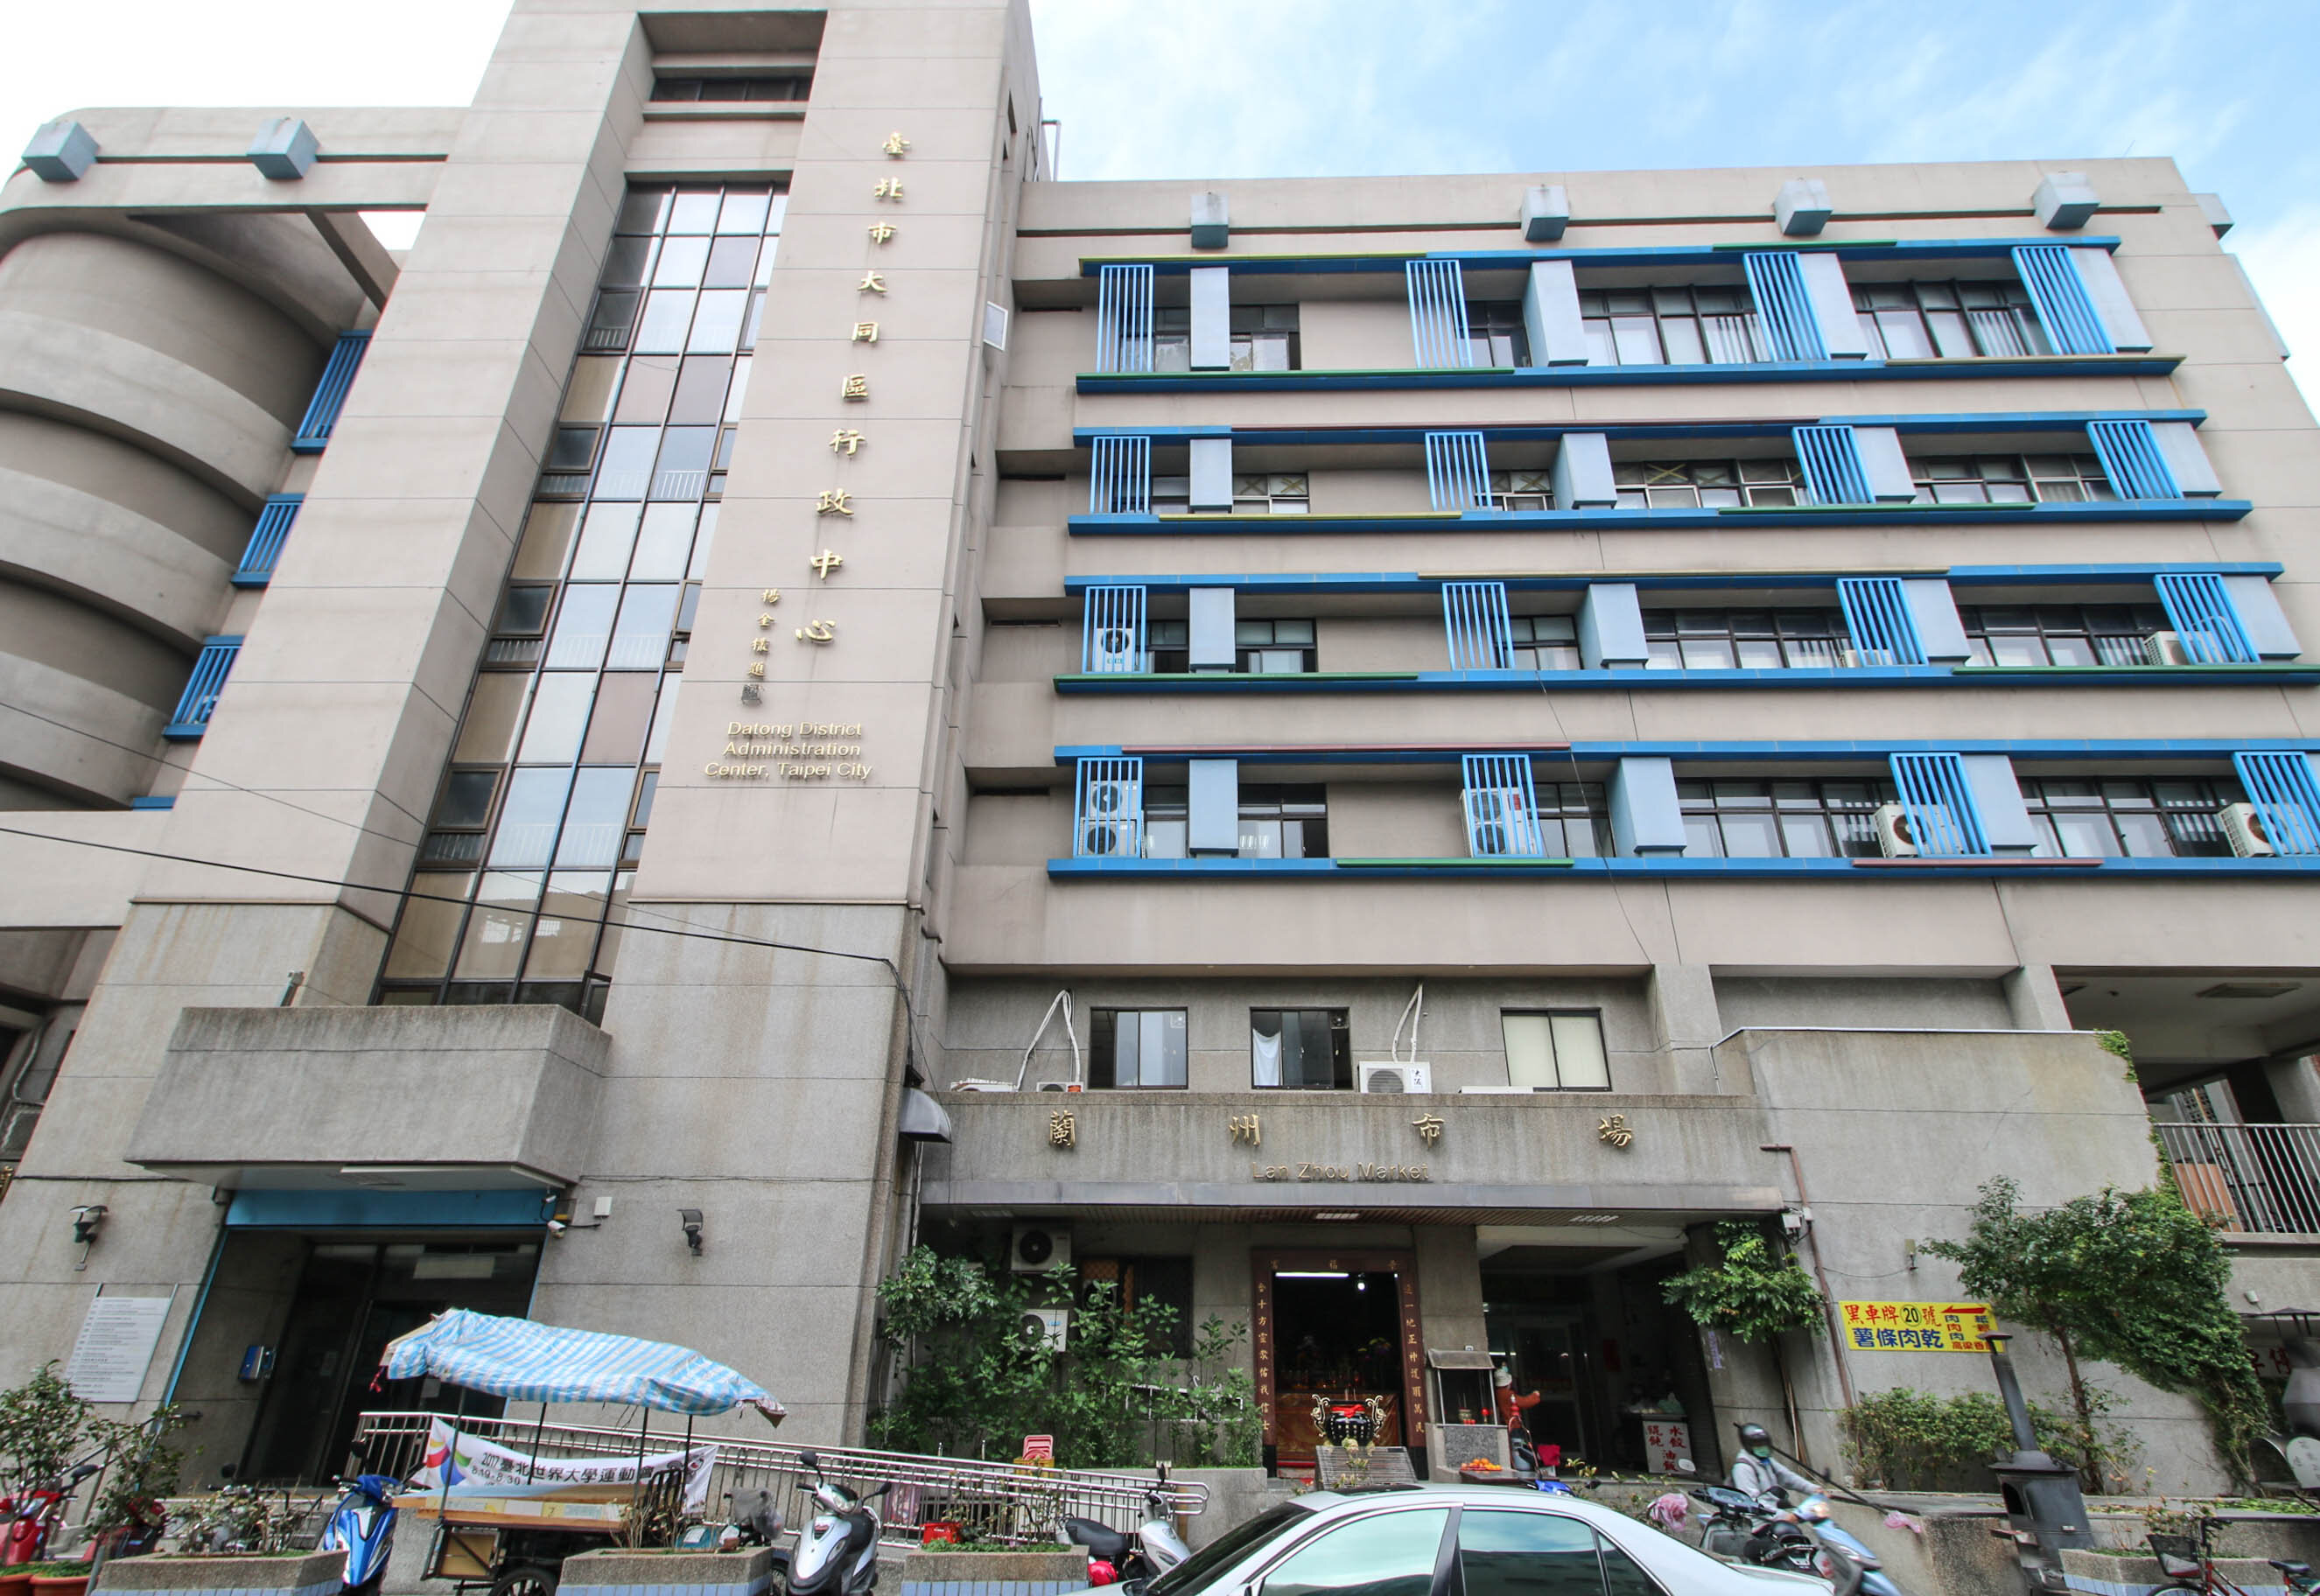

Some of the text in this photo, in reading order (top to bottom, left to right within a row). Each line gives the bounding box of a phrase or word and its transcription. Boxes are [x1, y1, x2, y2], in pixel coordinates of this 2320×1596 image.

[795, 131, 912, 644] 臺北市大同區行政中心
[727, 721, 863, 738] Datong District
[723, 741, 862, 758] Administration
[704, 762, 873, 783] Center, Taipei City
[1048, 1109, 1633, 1150] 蘭州市場
[1252, 1161, 1430, 1181] Lan Zhou Market
[1852, 1326, 1944, 1348] 薯條肉乾
[1669, 1424, 1686, 1448] 水餃
[481, 1452, 655, 1484] 2017 臺北世界大學運動會
